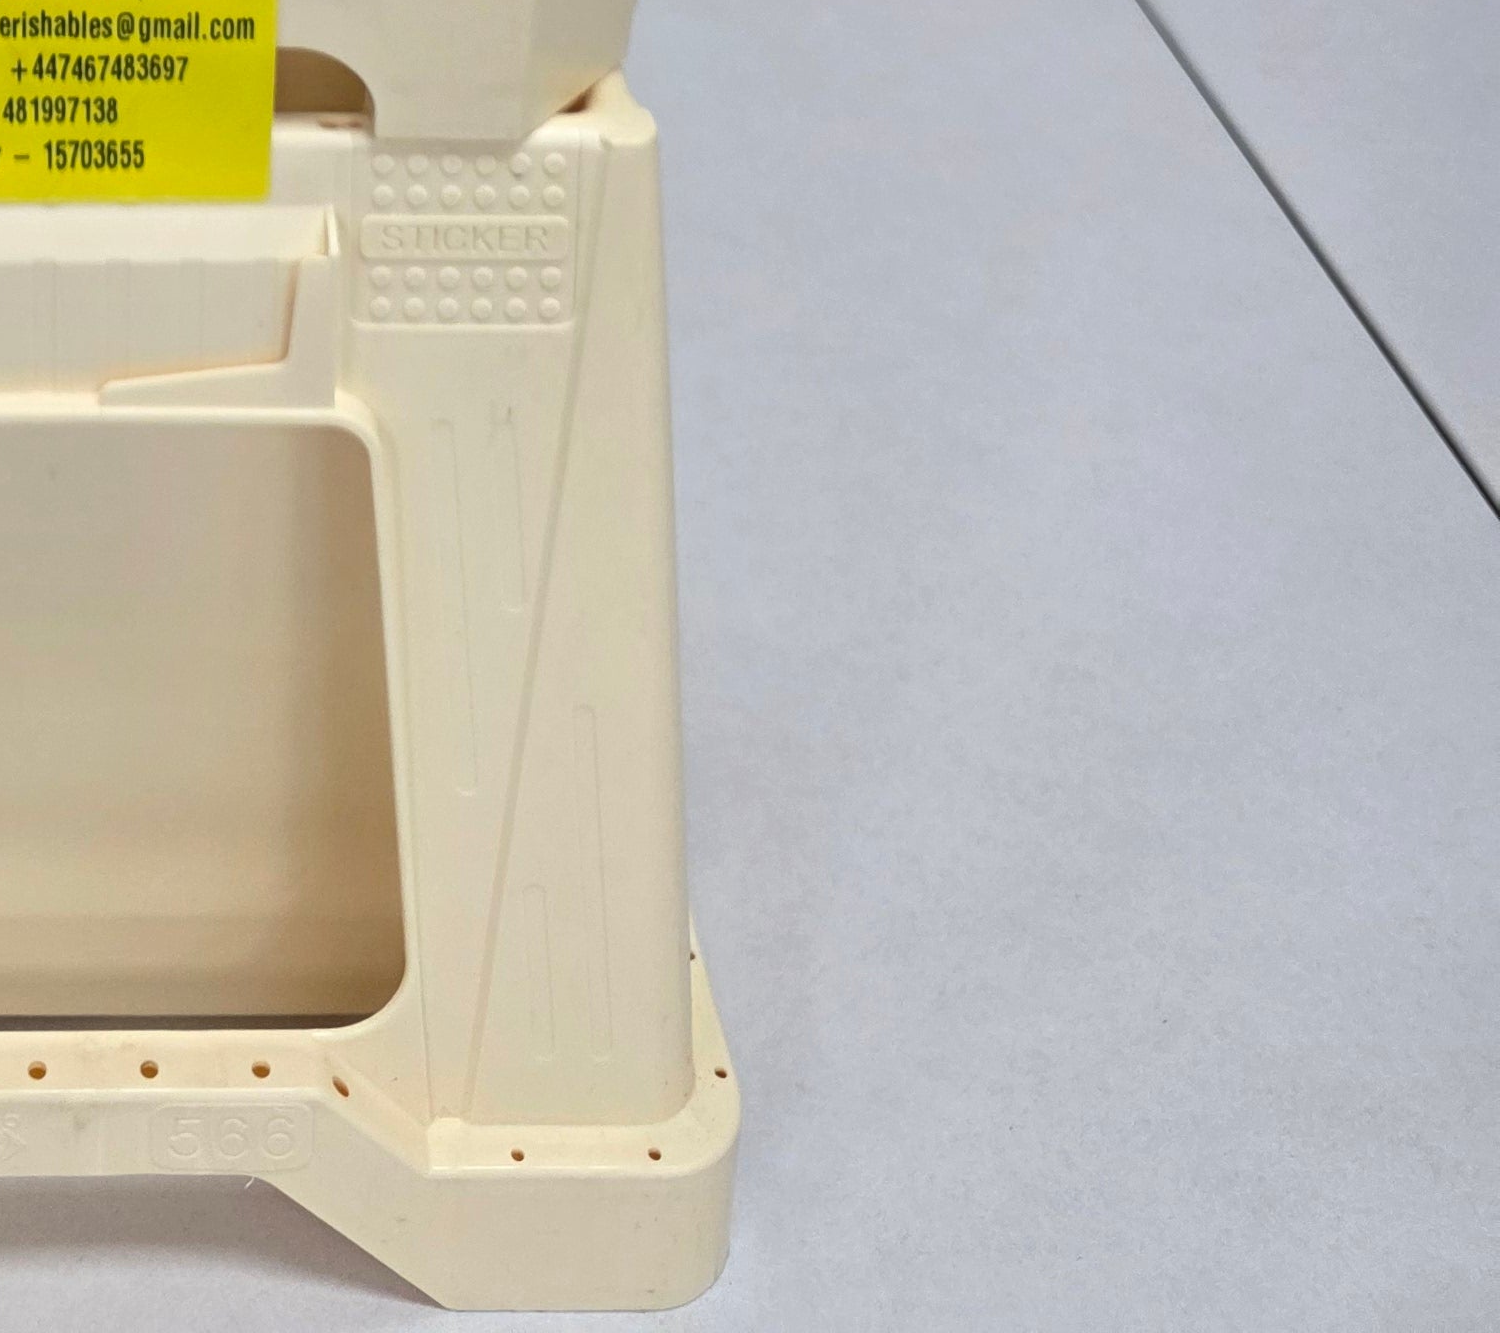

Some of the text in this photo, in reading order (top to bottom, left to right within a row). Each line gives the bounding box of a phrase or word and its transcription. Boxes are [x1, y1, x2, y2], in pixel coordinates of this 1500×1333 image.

[3, 96, 118, 124] 481997138
[44, 139, 144, 171] 15703655
[381, 223, 549, 251] STICKER
[167, 1116, 297, 1160] 566
